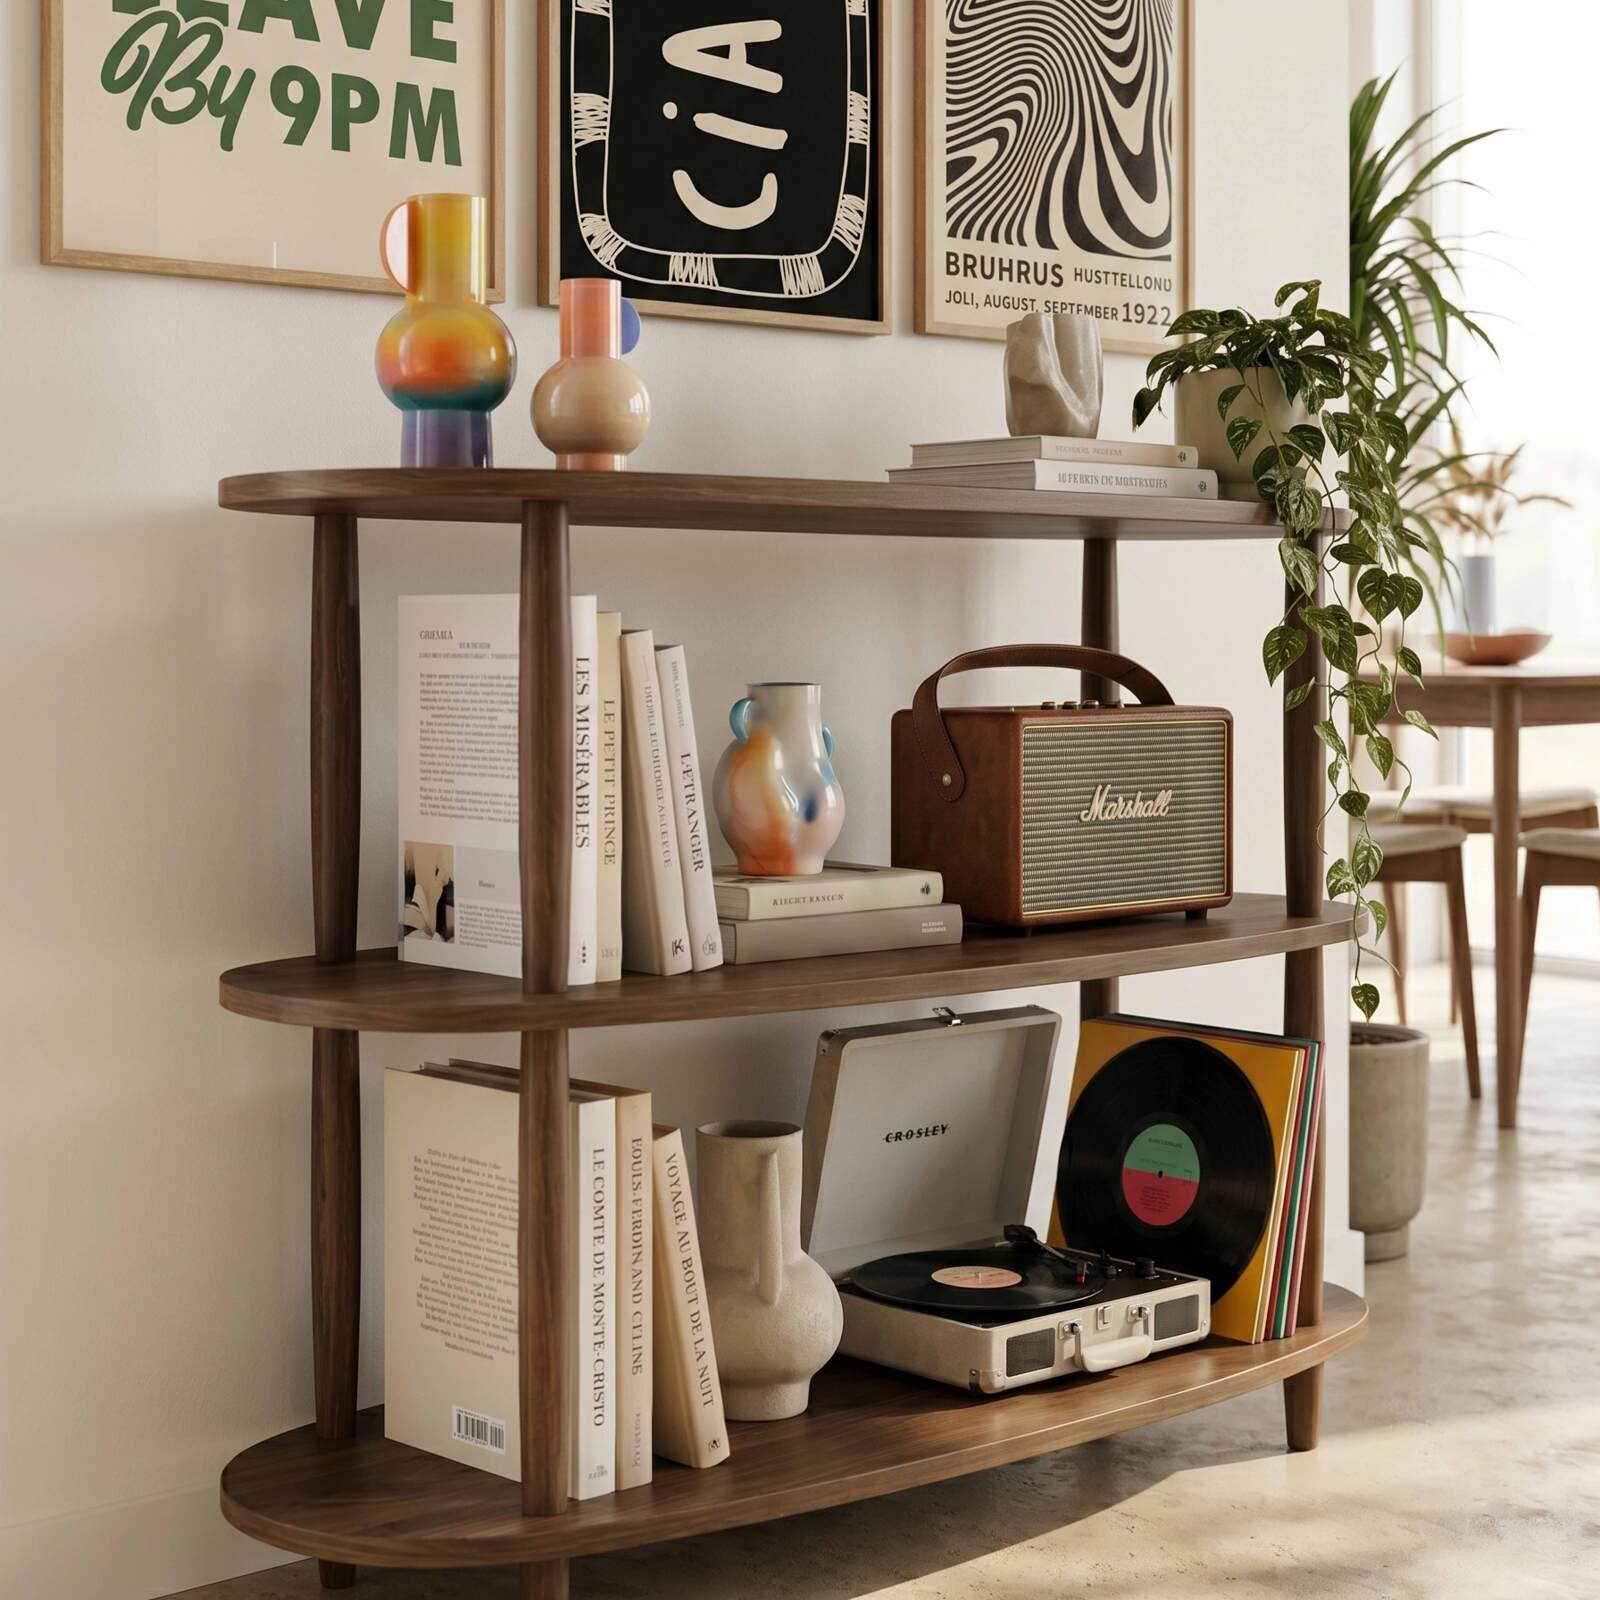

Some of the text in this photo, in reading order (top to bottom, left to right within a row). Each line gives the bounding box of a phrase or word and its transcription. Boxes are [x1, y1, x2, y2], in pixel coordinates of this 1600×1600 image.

[100, 10, 463, 167] By 9PM
[944, 290, 979, 309] JOLI,
[1121, 302, 1172, 326] 1922
[945, 251, 1064, 288] BRUHRUS
[575, 657, 593, 849] LES MISÉRABLES
[604, 700, 616, 865] LE PETIT PRINCE
[1080, 784, 1172, 822] Marshall
[884, 1124, 949, 1143] CROSLEY
[592, 1148, 605, 1427] LE COMTE DE MONTE-CRISTO
[665, 1153, 714, 1407] VOYAGE AU BOUT DE LA NUIT
